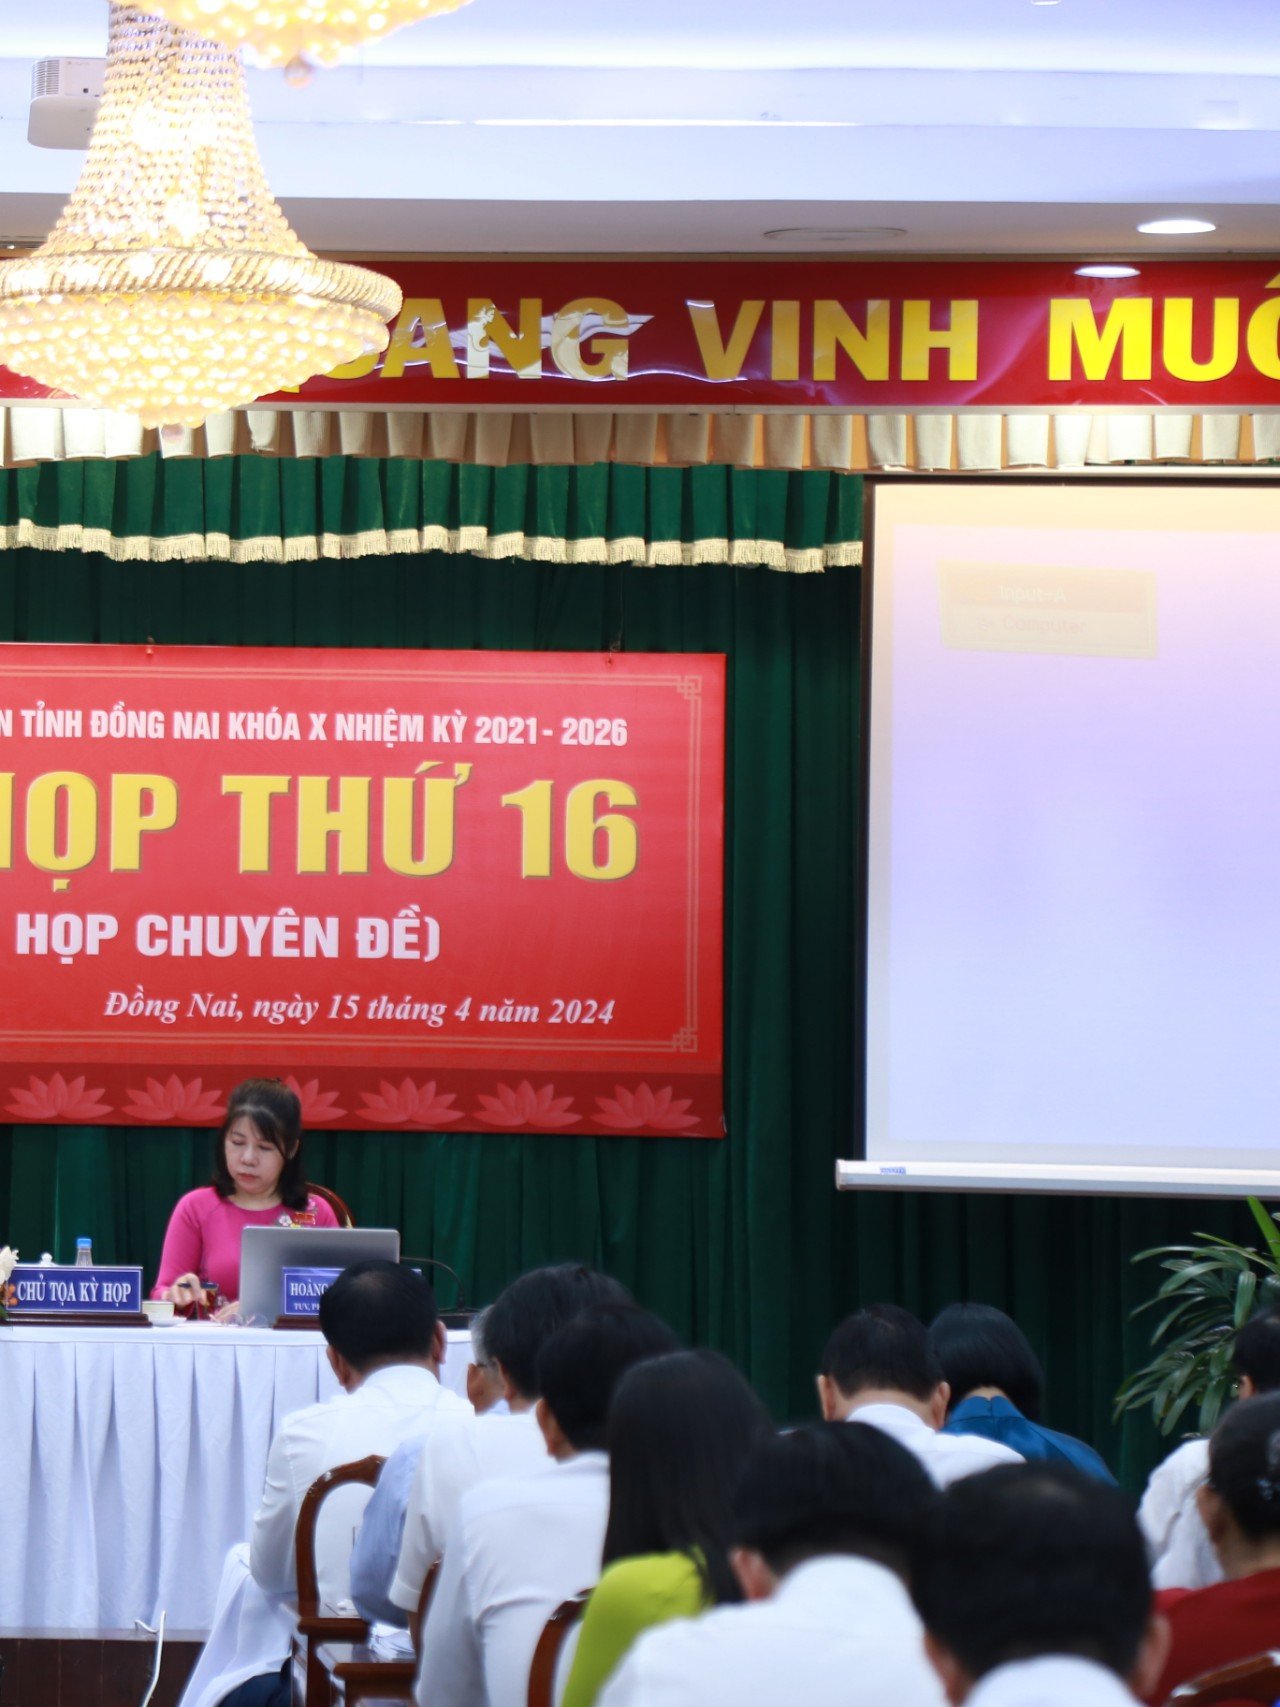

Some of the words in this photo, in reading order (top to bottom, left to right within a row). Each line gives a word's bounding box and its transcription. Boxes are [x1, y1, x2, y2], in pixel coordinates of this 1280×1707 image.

[285, 297, 629, 394] ANG
[686, 298, 980, 382] VINH
[999, 584, 1067, 604] Input-A
[1002, 615, 1088, 635] Computer
[20, 700, 83, 739] TỈNH
[90, 700, 165, 739] ĐỒNG
[173, 710, 220, 741] NAI
[228, 706, 301, 742] KHÓA
[307, 713, 327, 742] X
[335, 708, 424, 748] NHIỆM
[432, 709, 468, 744] KỲ
[561, 717, 629, 747] 2026
[221, 760, 474, 878] THỨ
[500, 778, 640, 882] 16
[15, 913, 119, 965] HỌP
[136, 906, 339, 958] CHUYÊN
[355, 903, 441, 963] ĐỀ)
[103, 984, 181, 1024] Đồng
[186, 992, 244, 1022] Nai,
[252, 993, 320, 1026] ngày
[327, 994, 360, 1020] 15
[366, 994, 447, 1028] tháng
[454, 996, 472, 1022] 4
[478, 998, 540, 1023] năm
[548, 999, 616, 1025] 2024
[17, 1272, 46, 1302] CHỦ
[49, 1280, 76, 1307] TỌA
[80, 1276, 99, 1303] KỲ
[102, 1282, 132, 1308] HỌP
